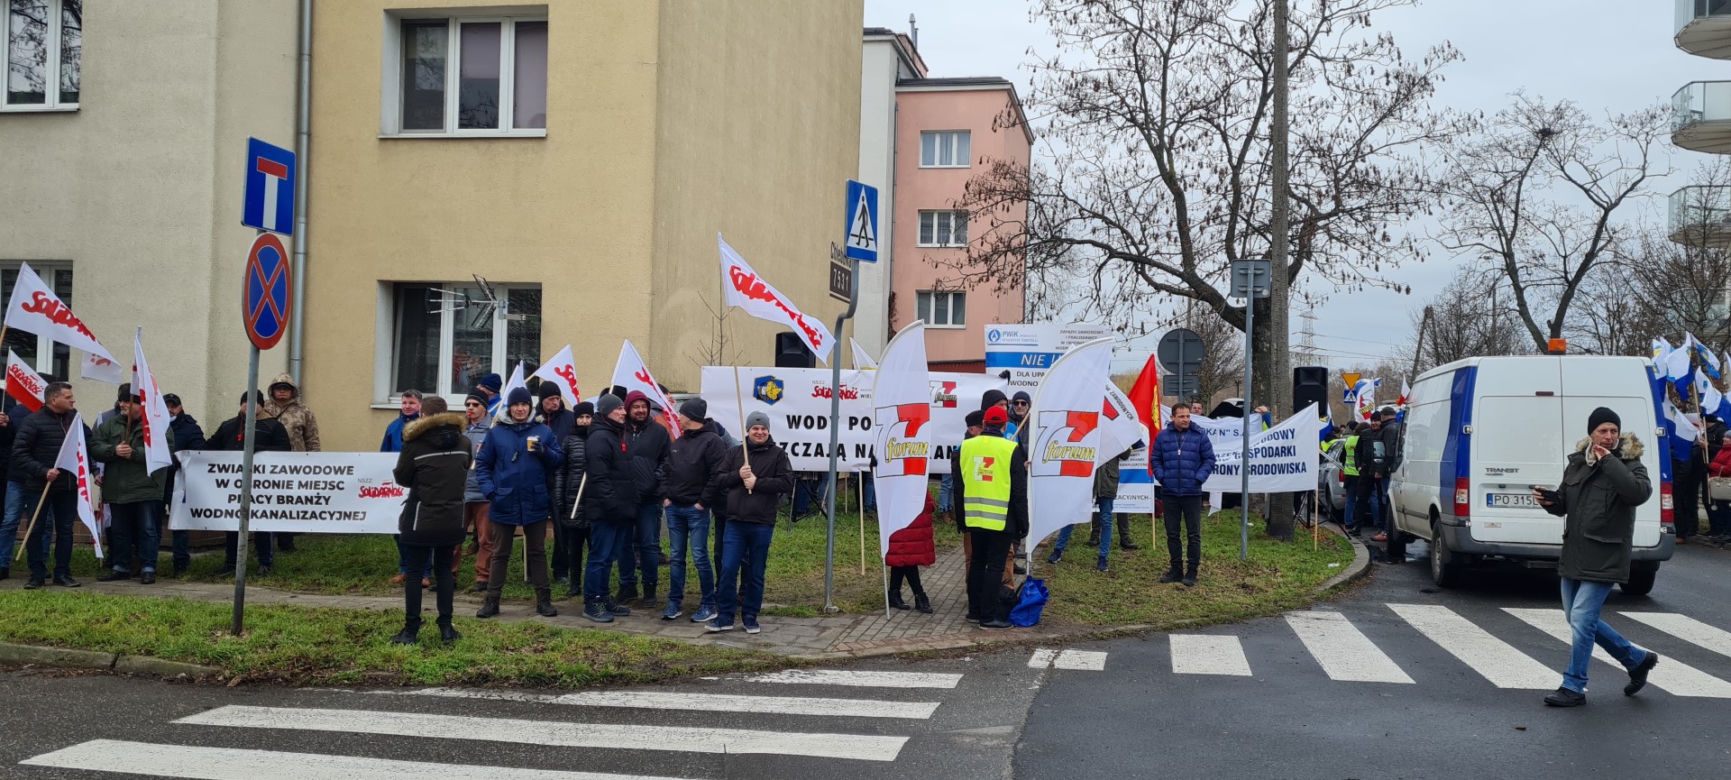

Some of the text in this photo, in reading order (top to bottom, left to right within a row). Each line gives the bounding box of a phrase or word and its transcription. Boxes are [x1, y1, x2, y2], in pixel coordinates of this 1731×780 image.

[1021, 354, 1046, 366] NIE
[886, 437, 929, 463] forum
[1042, 440, 1096, 464] forum
[269, 465, 355, 475] ZAWODOWE
[215, 478, 345, 491] W ORONIE MIEJSC
[277, 492, 331, 505] BRANŻY
[1494, 495, 1509, 504] PO
